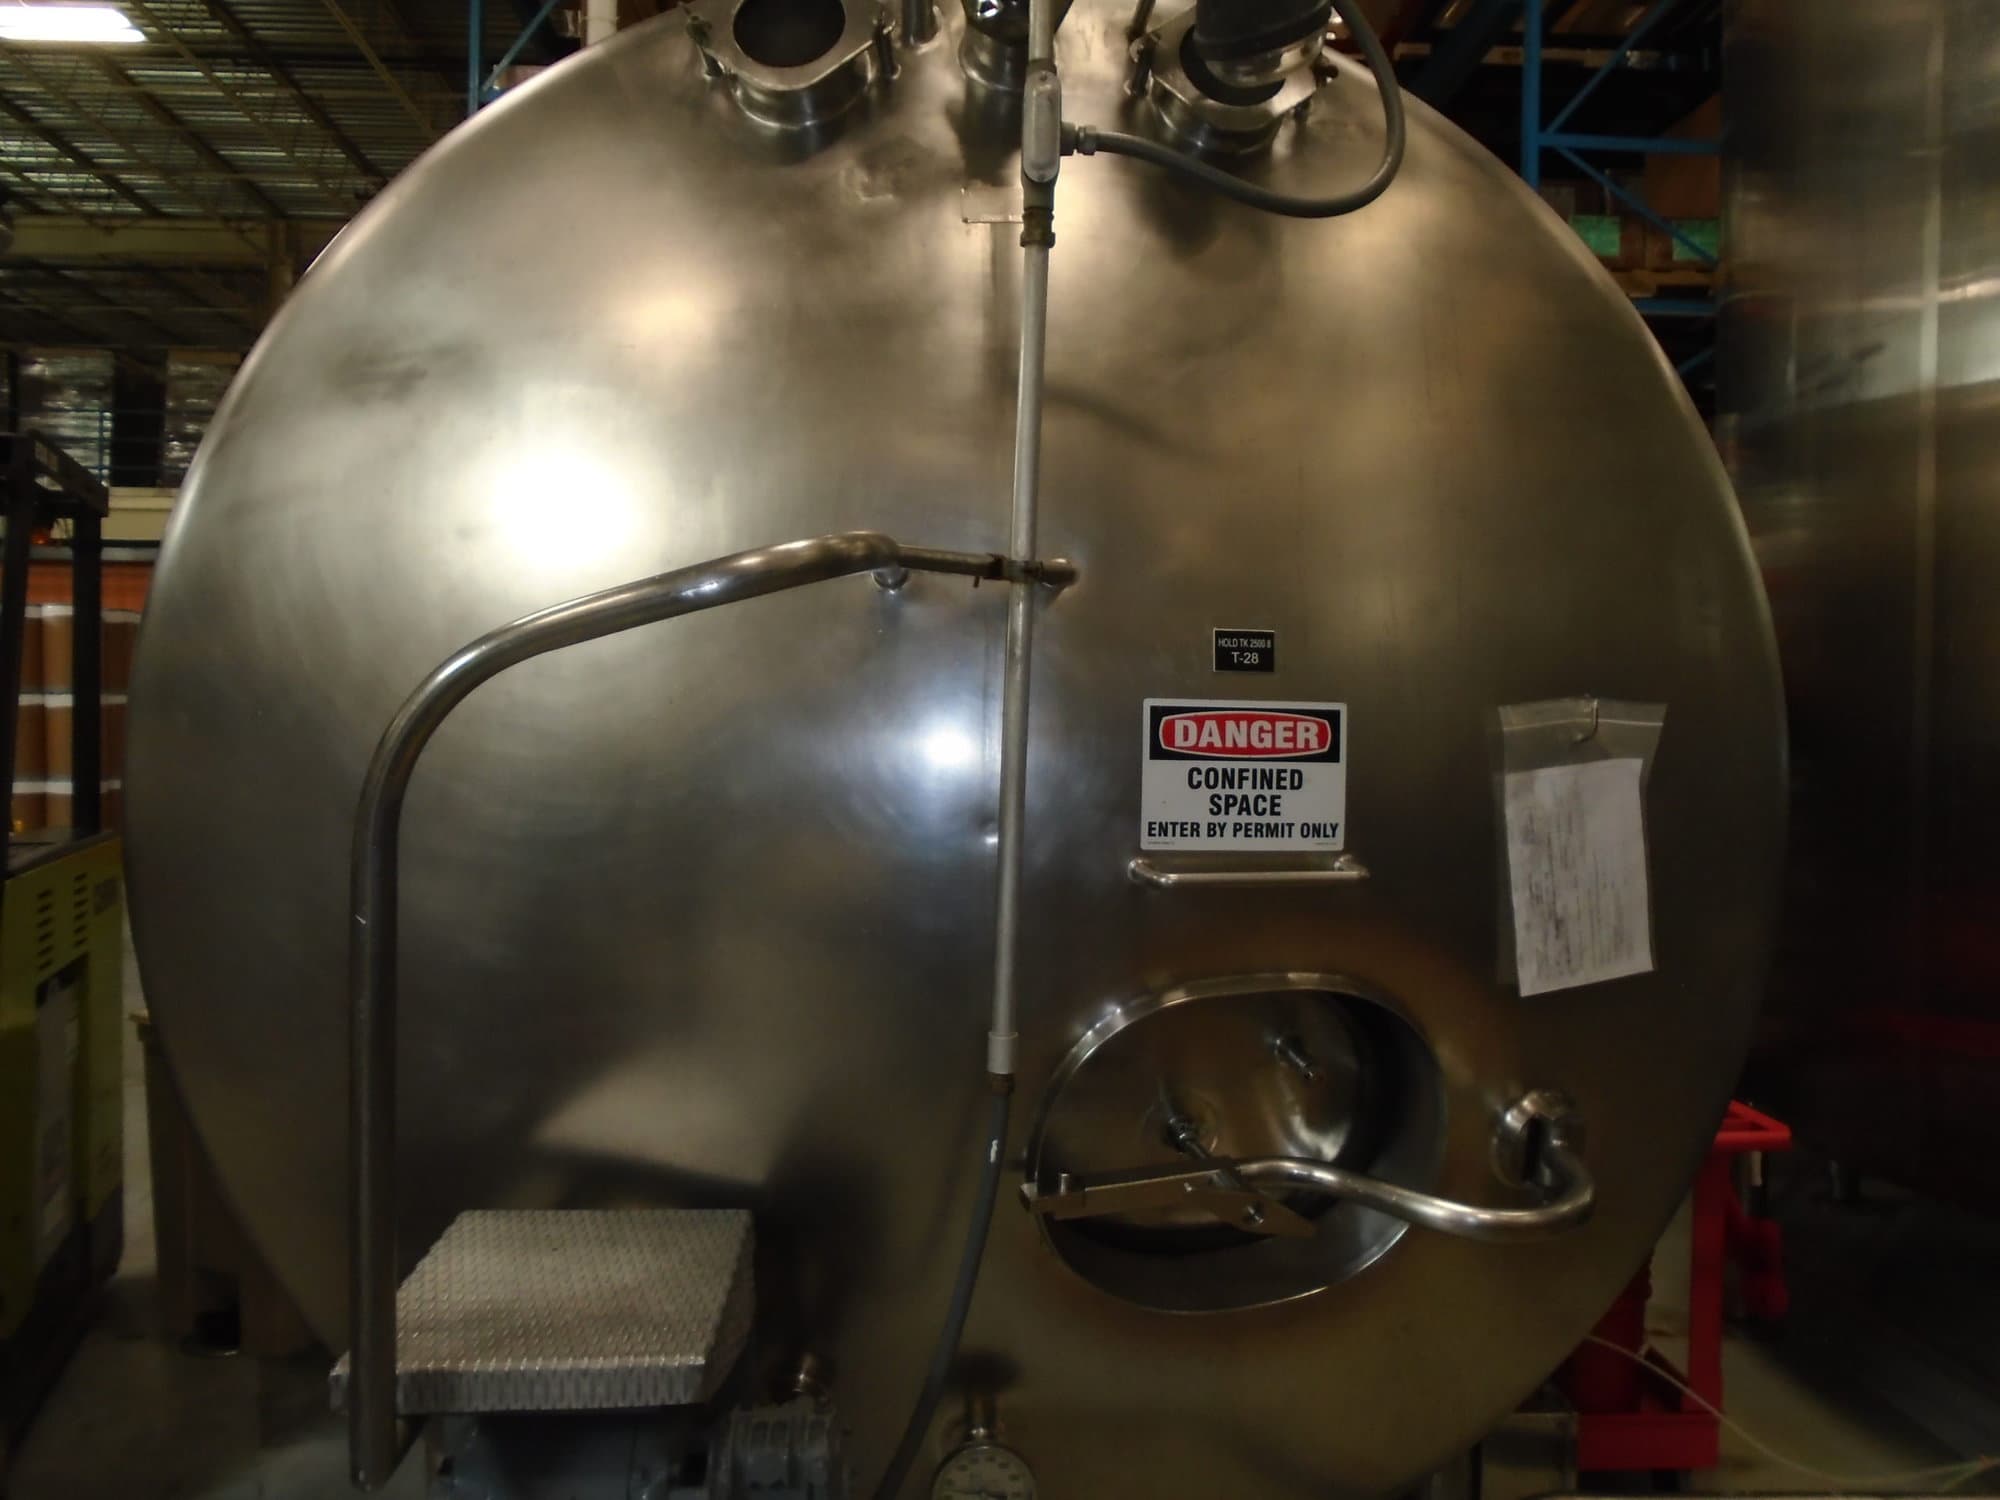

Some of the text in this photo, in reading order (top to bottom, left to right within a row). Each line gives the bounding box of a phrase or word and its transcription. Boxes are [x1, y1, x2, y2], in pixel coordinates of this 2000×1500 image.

[1218, 638, 1238, 648] HOLD
[1239, 638, 1249, 648] TK
[1231, 651, 1259, 665] T-28
[1174, 719, 1319, 749] DANGER
[1187, 767, 1304, 791] CONFINED
[1208, 794, 1282, 817] SPACE
[1147, 821, 1339, 839] ENTER BY PERMIT ONLY
